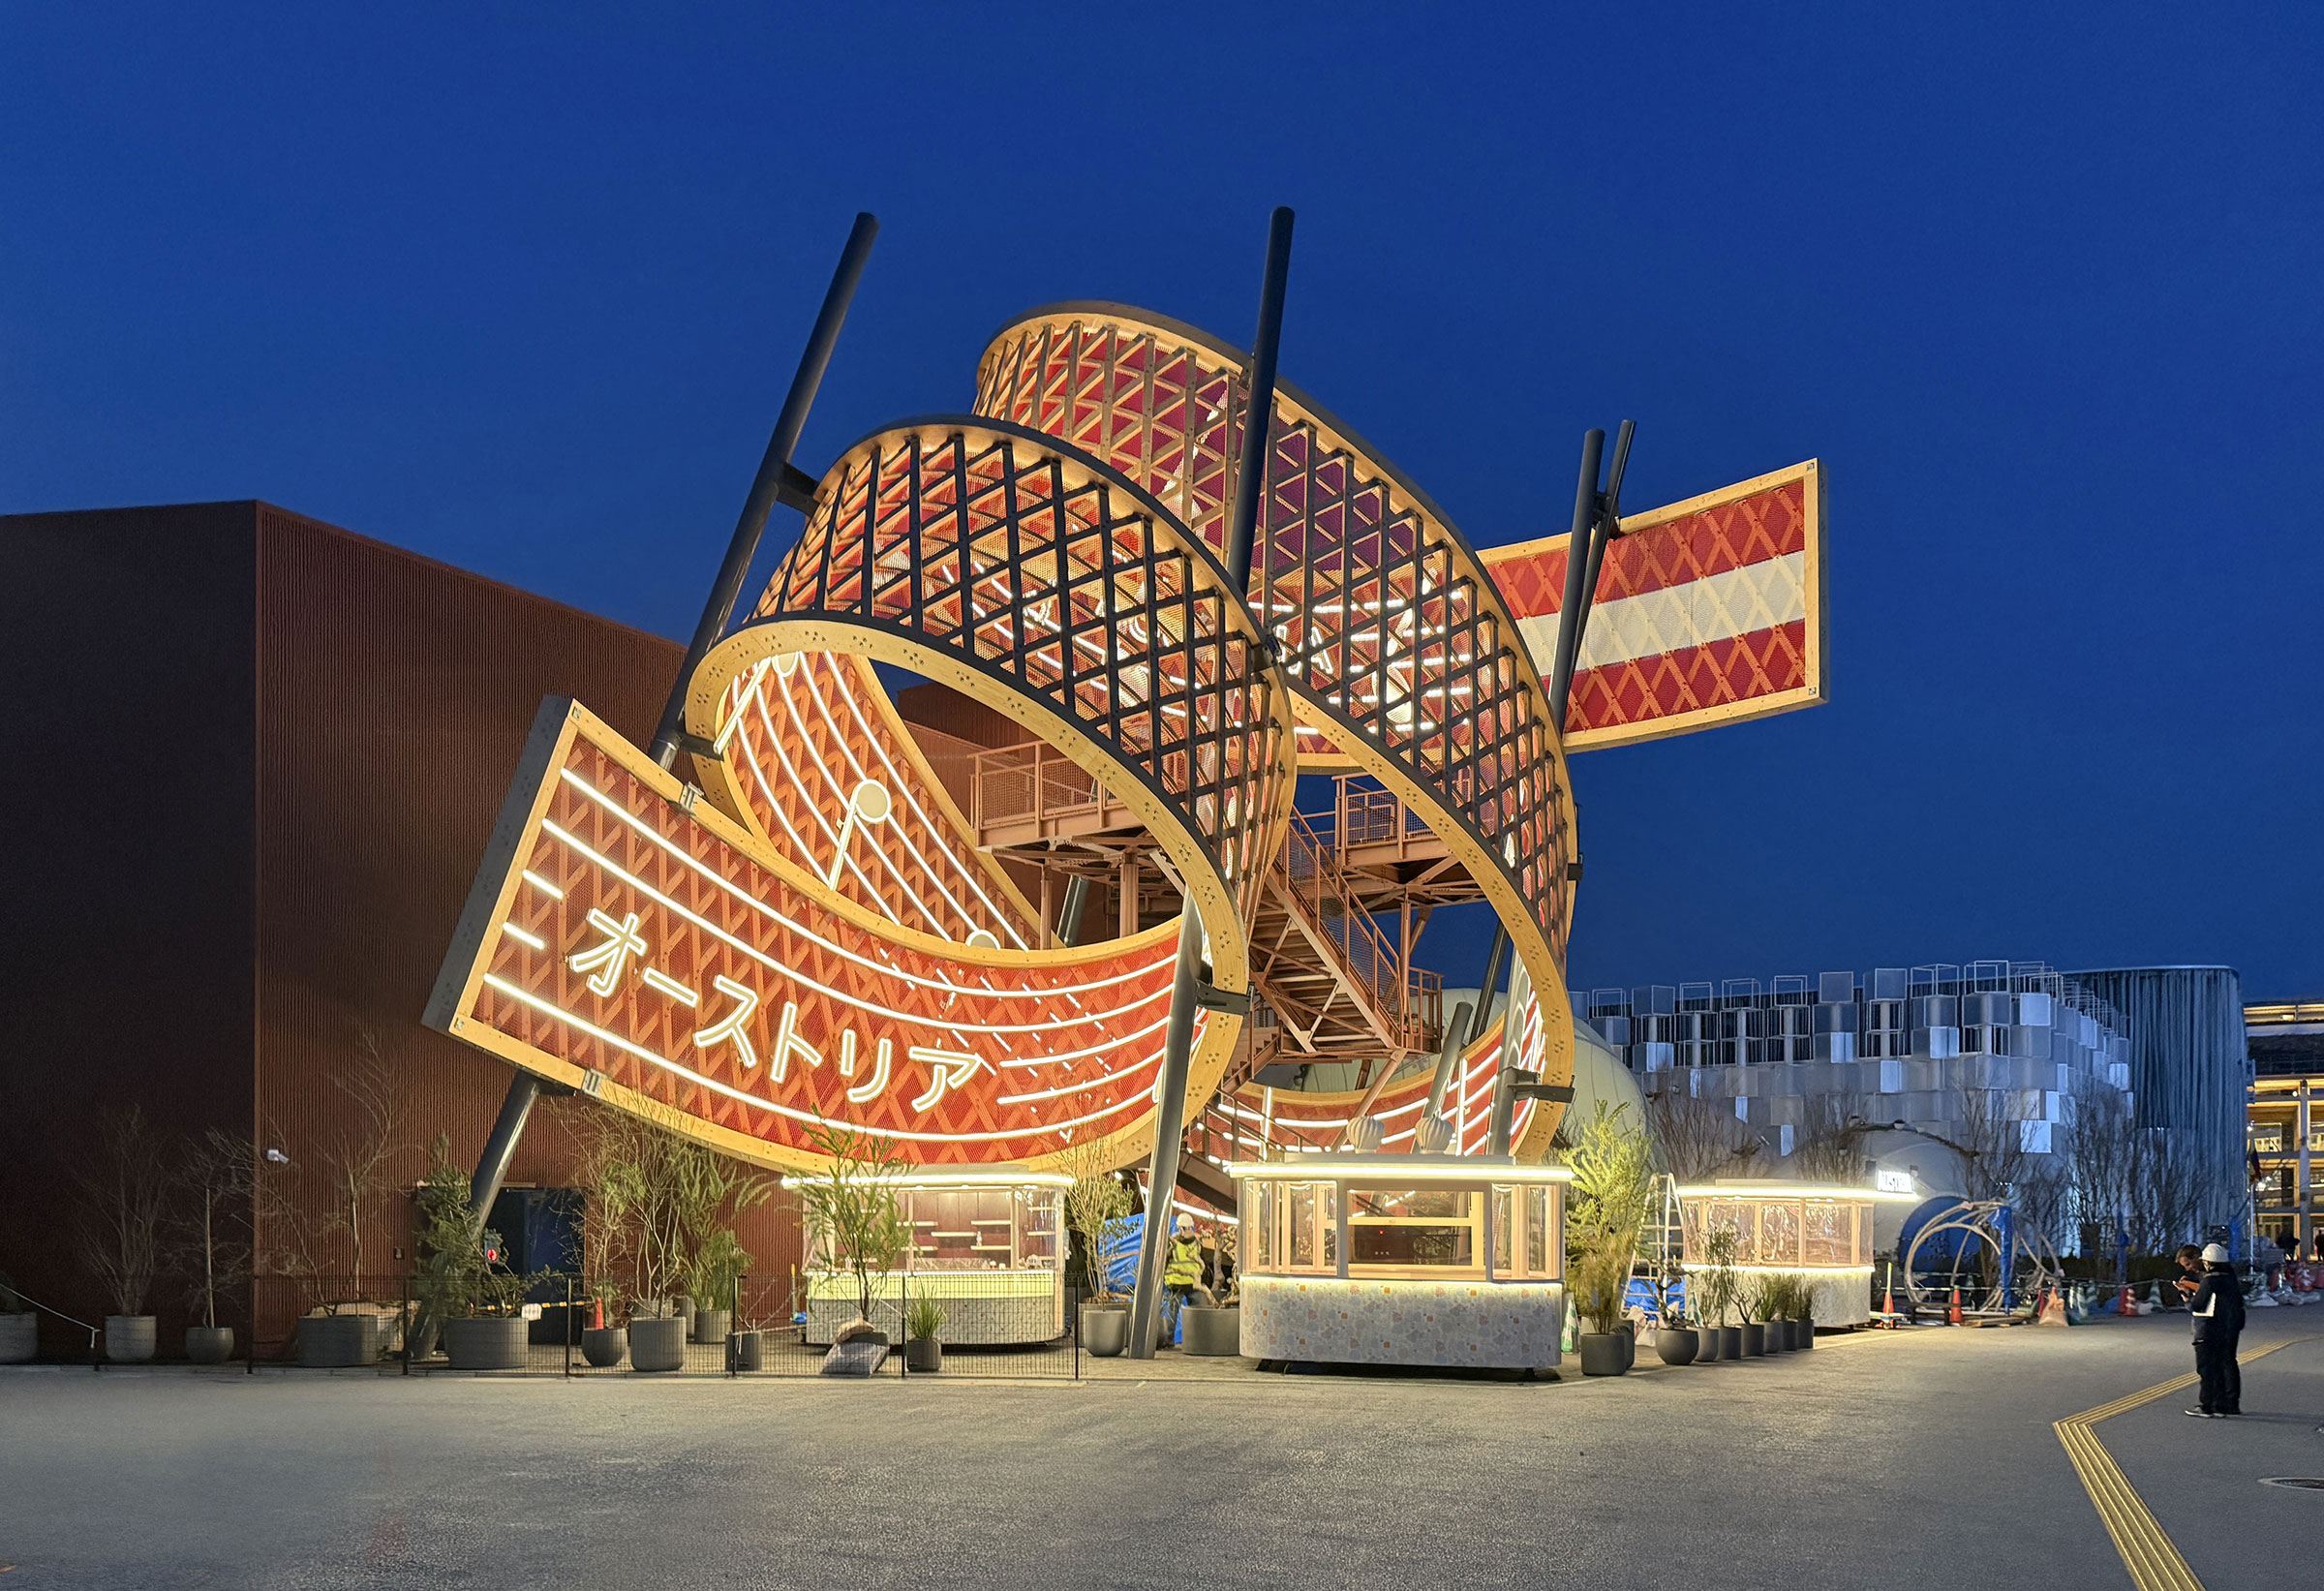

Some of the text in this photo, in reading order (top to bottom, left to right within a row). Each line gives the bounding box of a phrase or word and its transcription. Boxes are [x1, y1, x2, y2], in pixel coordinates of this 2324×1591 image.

[569, 906, 983, 1113] オーストリア
